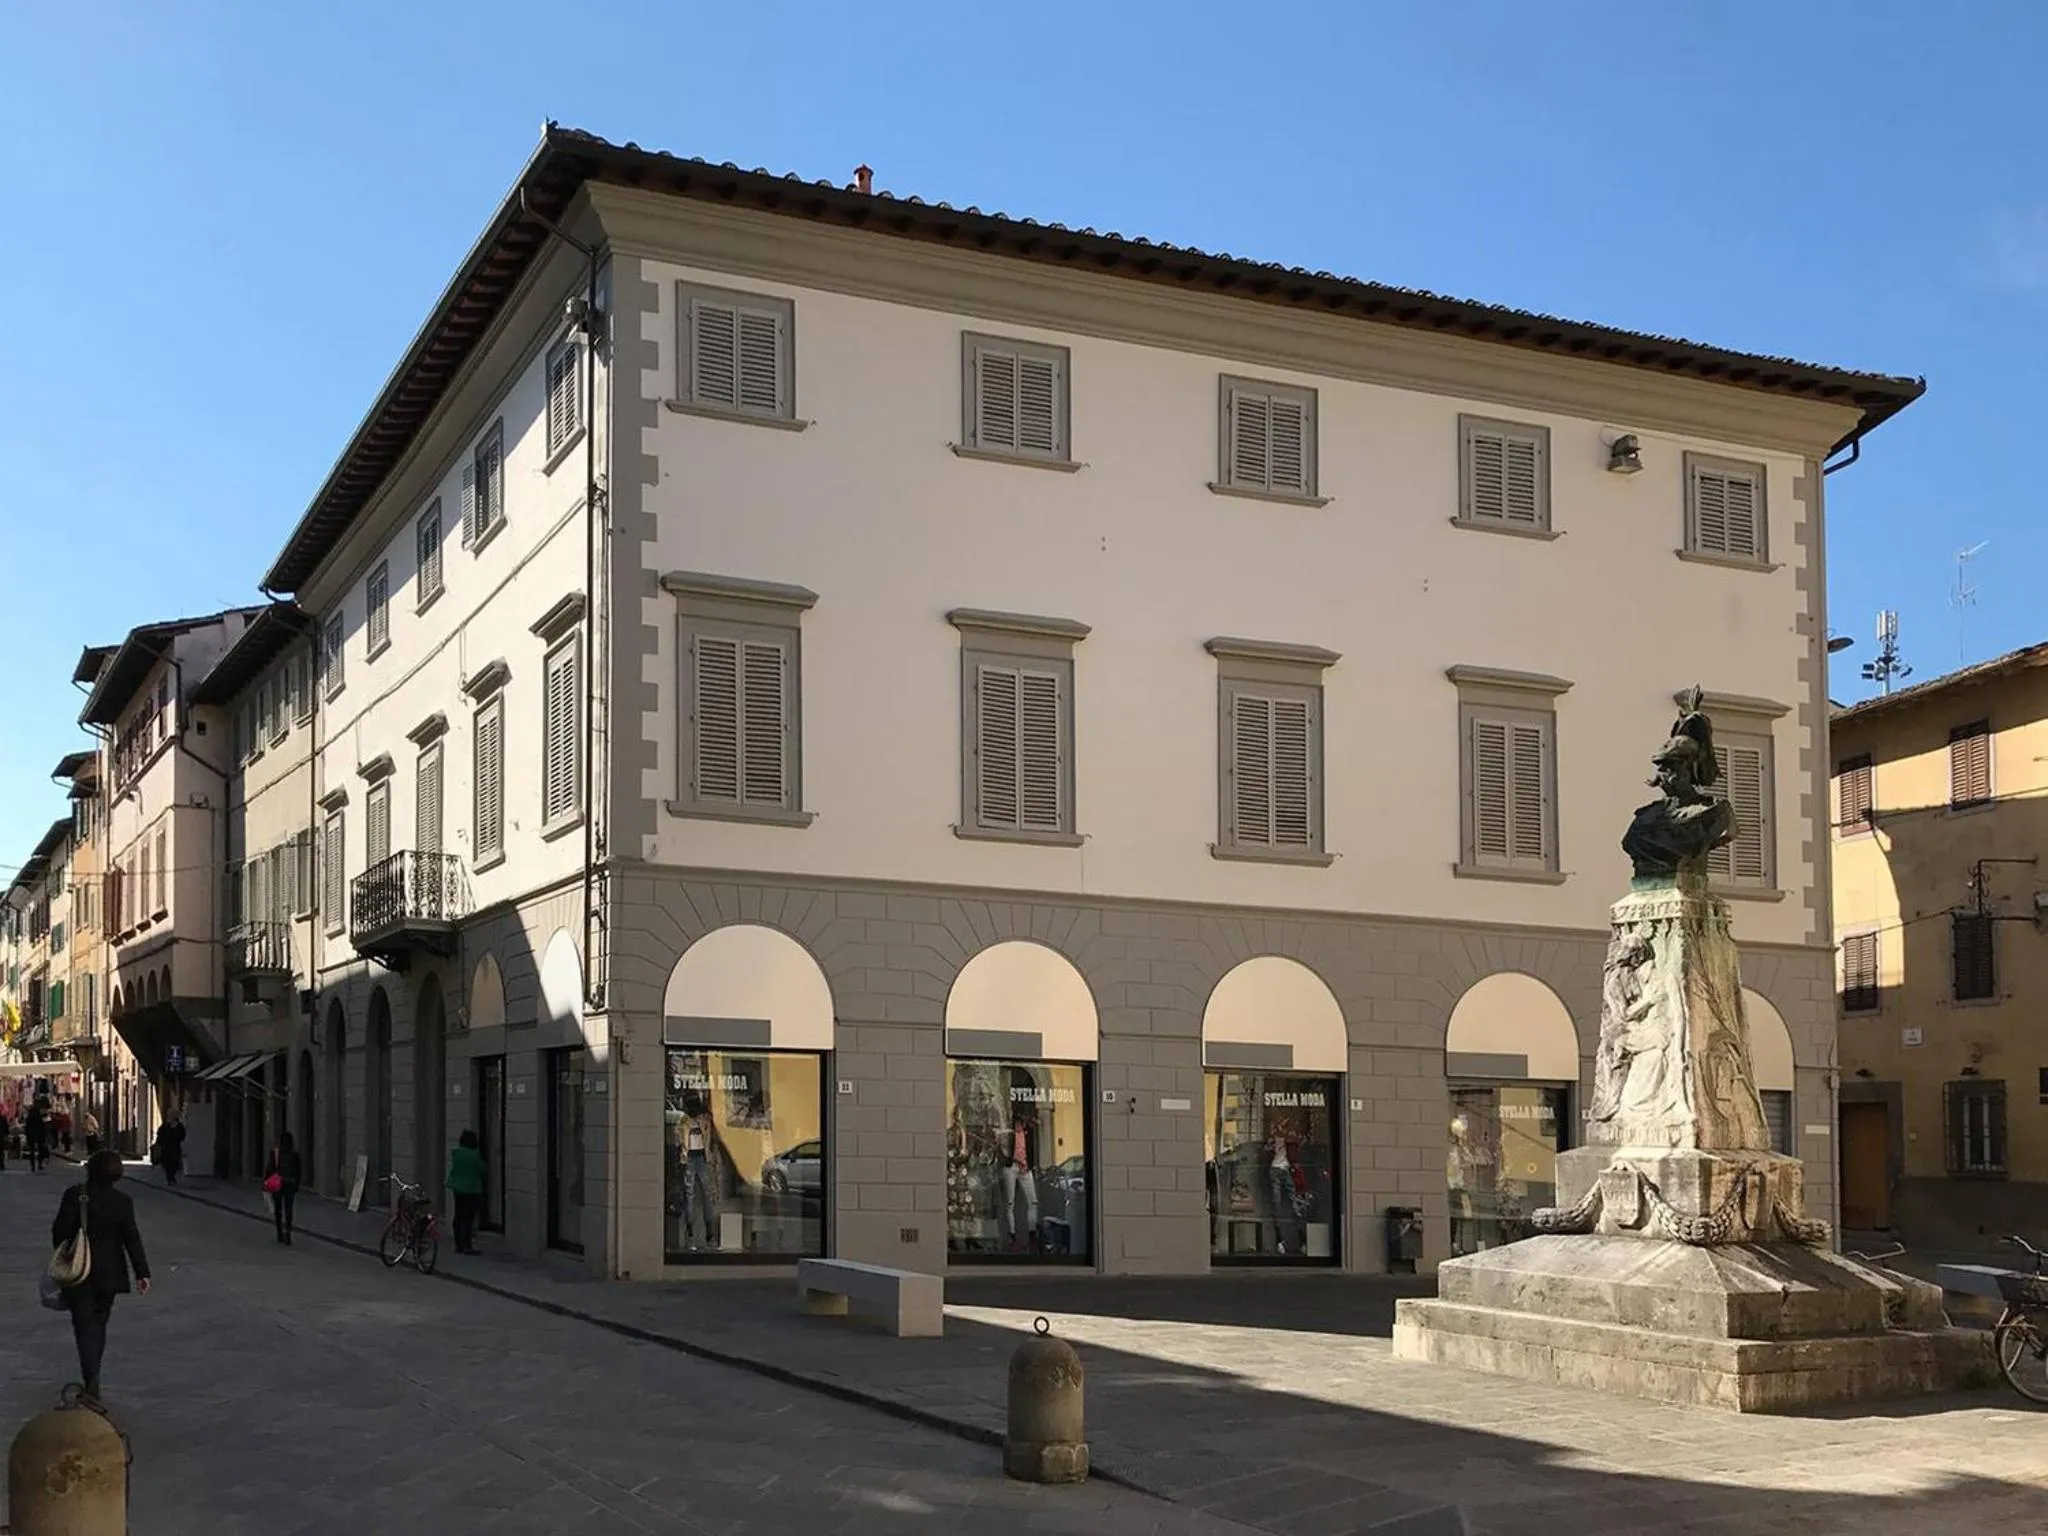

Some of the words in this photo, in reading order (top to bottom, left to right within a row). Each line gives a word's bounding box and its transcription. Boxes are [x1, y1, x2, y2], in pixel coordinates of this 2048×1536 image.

[673, 1073, 715, 1090] STELLA
[717, 1074, 748, 1090] MODA
[1009, 1087, 1047, 1103] STELLA
[1049, 1088, 1076, 1104] MODA
[1263, 1092, 1299, 1107] STELLA
[1299, 1092, 1326, 1107] MODA
